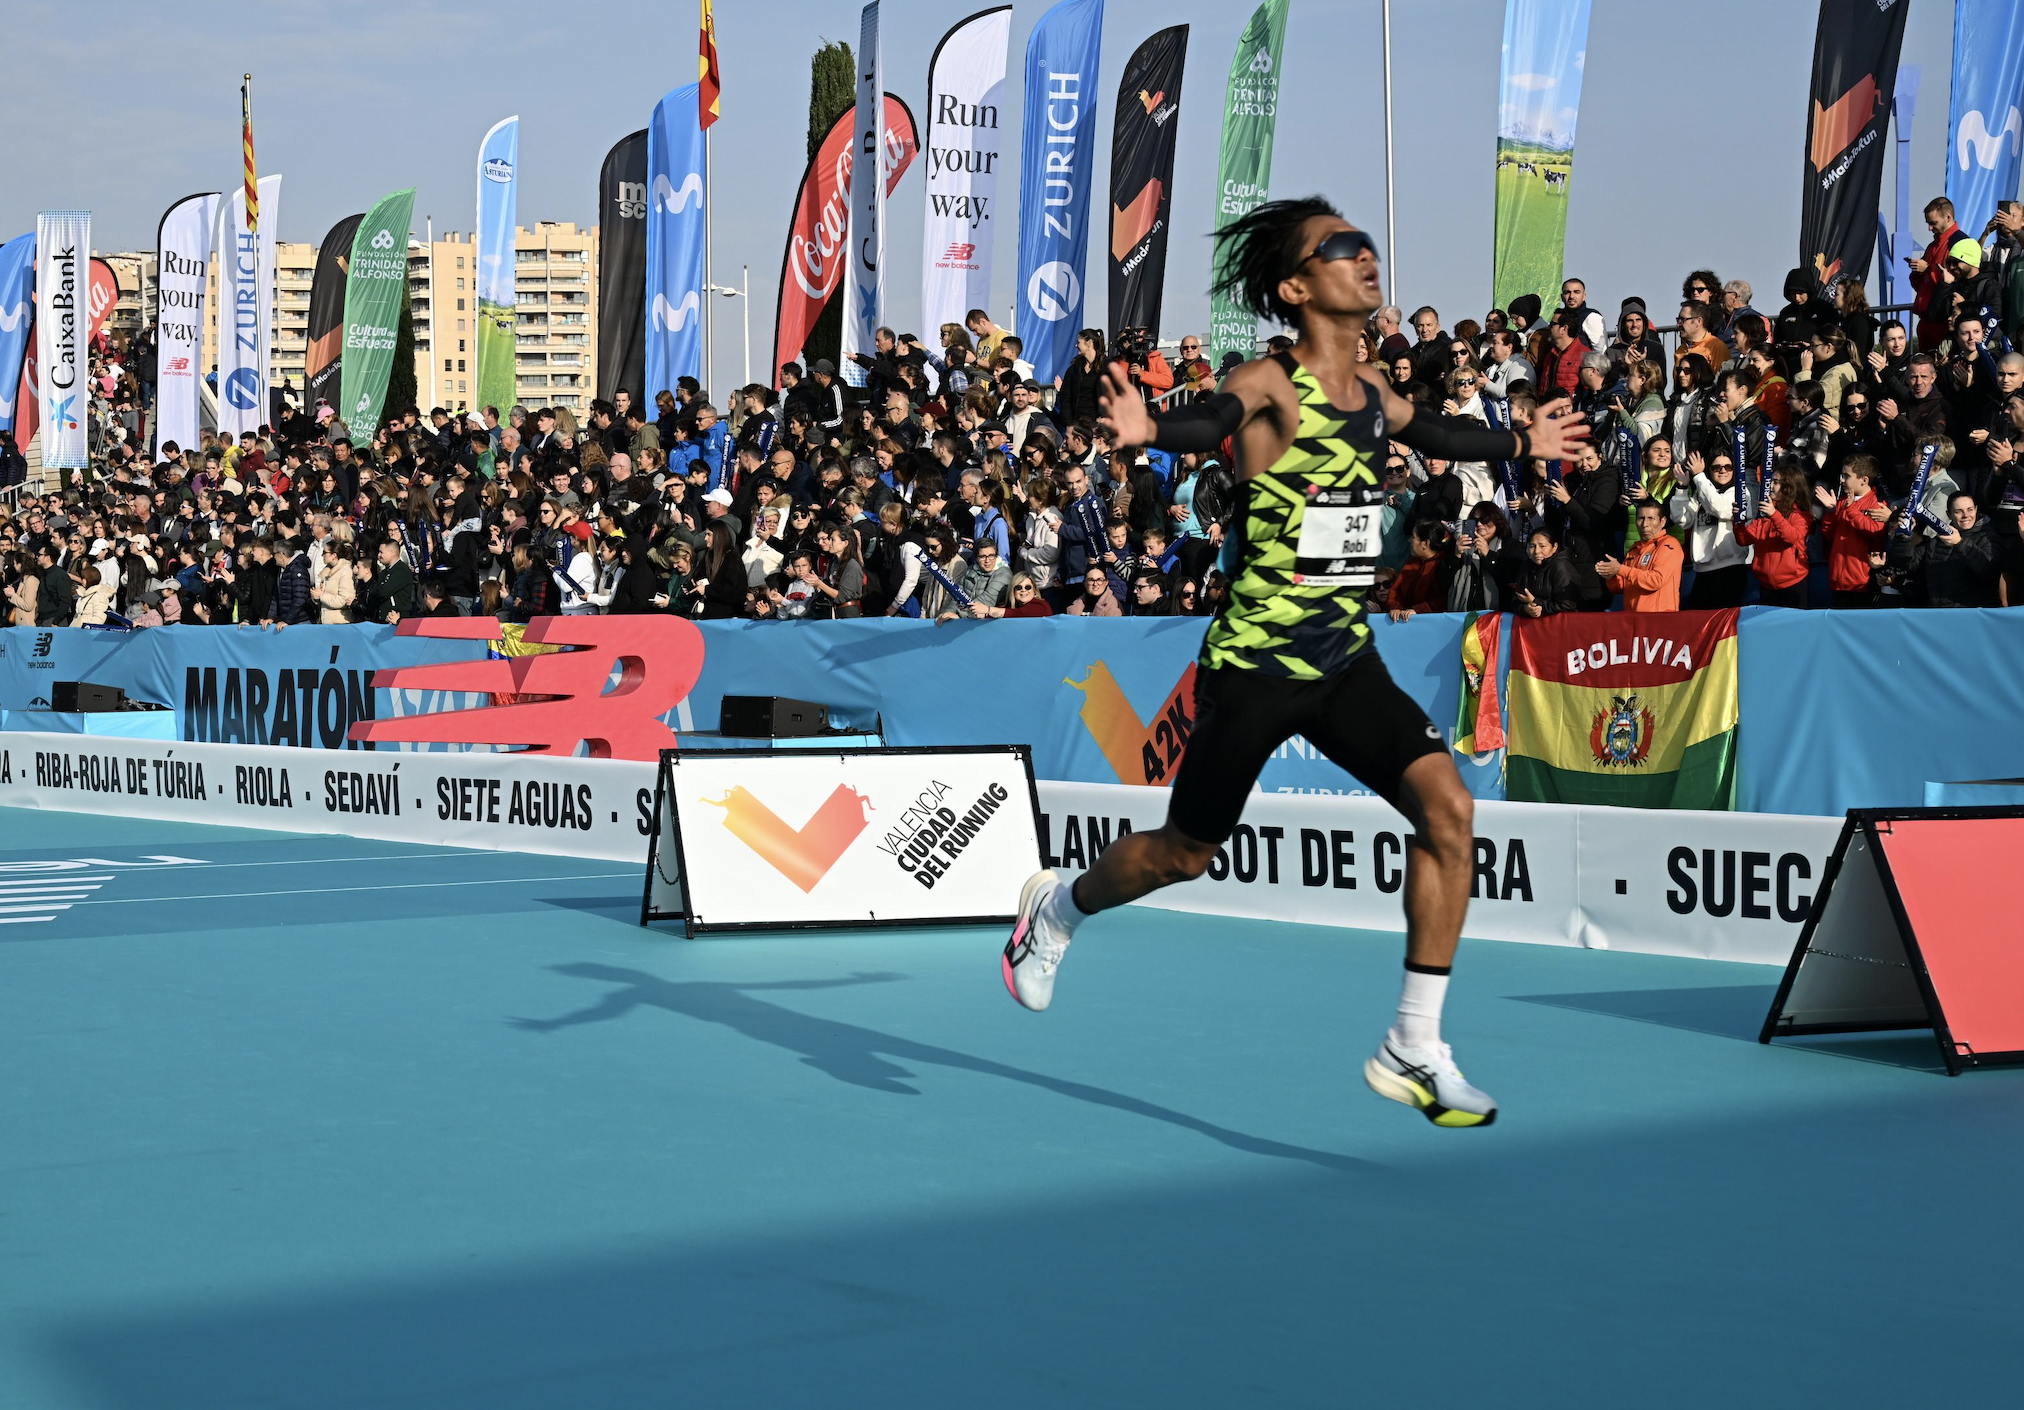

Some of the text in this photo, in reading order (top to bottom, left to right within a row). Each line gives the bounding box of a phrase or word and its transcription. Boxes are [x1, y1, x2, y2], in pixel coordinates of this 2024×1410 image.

[935, 93, 998, 129] Run
[931, 147, 998, 180] your
[1044, 71, 1080, 240] ZURICH
[930, 194, 989, 229] way.
[163, 250, 206, 278] Run
[353, 269, 404, 280] ALFONSO
[354, 259, 405, 270] TRINIDAD
[951, 261, 980, 270] balance
[161, 289, 205, 313] your
[236, 233, 260, 352] ZURICH
[51, 245, 76, 389] CaixaBank
[161, 322, 198, 347] way.
[349, 323, 388, 337] Cultura
[346, 336, 396, 350] Esfuerzo
[1345, 515, 1369, 533] 347
[1342, 539, 1367, 554] Robi
[36, 660, 55, 669] balance
[1567, 636, 1693, 676] BOLIVIA
[184, 645, 376, 751] MARATÓN
[1142, 692, 1194, 785] 42K
[36, 750, 207, 801] RIBA-ROJA DE TÚRIA
[236, 765, 293, 808] RIOLA
[325, 763, 401, 816] SEDAVÍ
[437, 776, 592, 831] SIETE AGUAS
[876, 780, 953, 855] VALENCIA
[897, 807, 957, 872] CIUDAD
[913, 782, 1009, 890] DEL RUNNING
[1300, 828, 1357, 890] DE
[1666, 846, 1832, 923] SUEC
